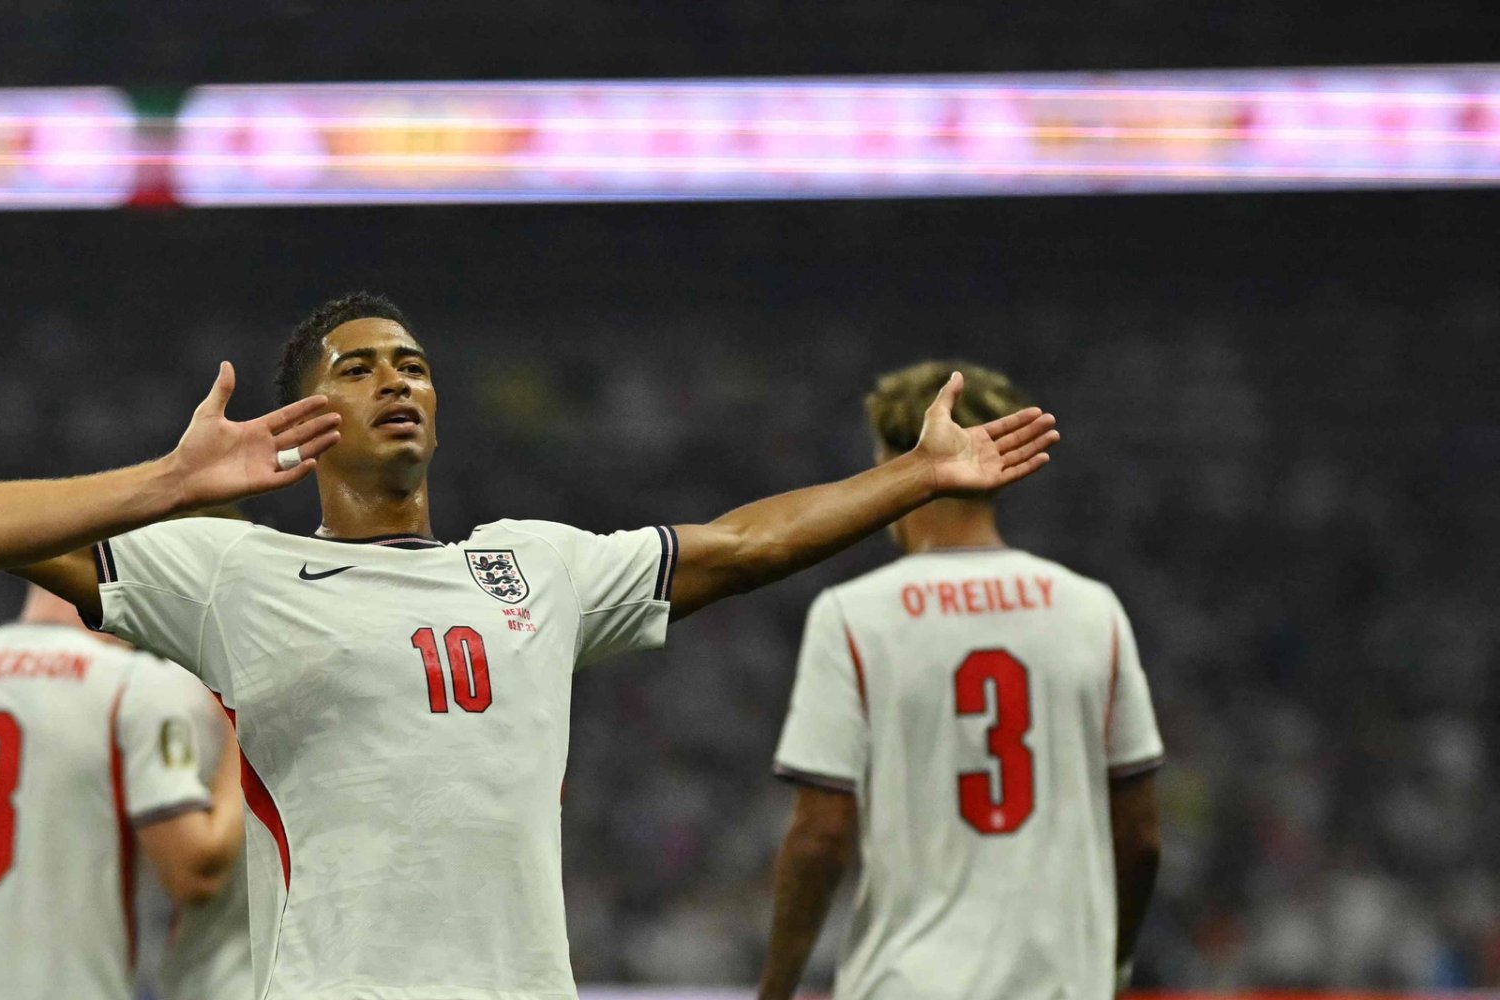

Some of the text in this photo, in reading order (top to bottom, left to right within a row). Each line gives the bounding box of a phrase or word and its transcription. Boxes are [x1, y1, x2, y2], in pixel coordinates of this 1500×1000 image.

[502, 607, 531, 620] MEXICO
[902, 576, 1053, 617] O'REILLY
[411, 626, 493, 713] 10
[954, 648, 1034, 835] 3
